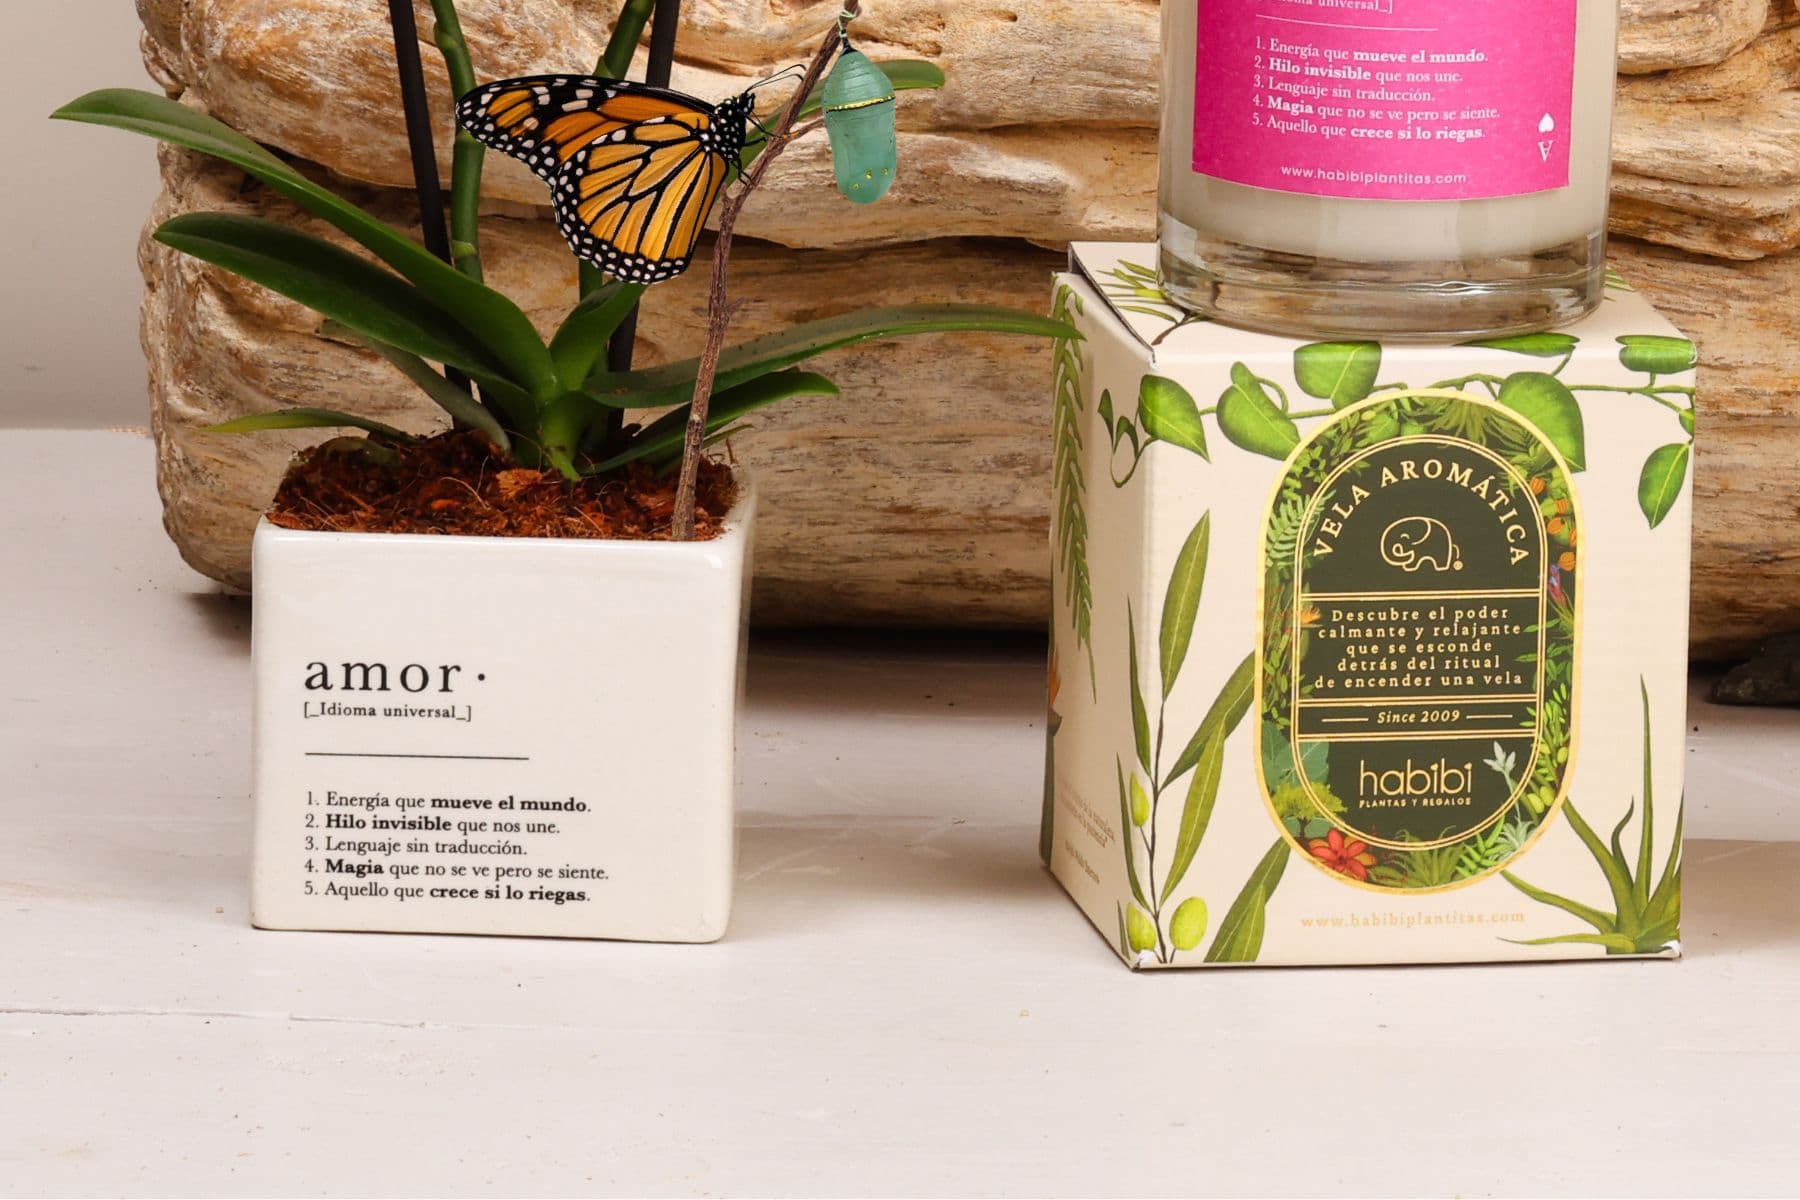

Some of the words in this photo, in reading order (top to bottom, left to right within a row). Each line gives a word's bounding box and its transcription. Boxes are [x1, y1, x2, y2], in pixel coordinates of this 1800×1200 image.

[1256, 36, 1265, 49] 1.
[1270, 39, 1319, 56] Energía
[1324, 48, 1349, 62] que
[1353, 51, 1407, 62] mueve
[1411, 50, 1426, 62] el
[1430, 49, 1488, 62] mundo.
[1254, 56, 1265, 69] 2.
[1269, 59, 1300, 73] Hilo
[1305, 63, 1371, 80] invisible
[1376, 71, 1401, 84] que
[1407, 72, 1430, 82] nos
[1254, 75, 1264, 88] 3.
[1269, 77, 1328, 99] Lenguaje
[1332, 84, 1351, 98] sin
[1356, 87, 1434, 102] traducción.
[1253, 95, 1263, 107] 4.
[1268, 97, 1313, 114] Magia
[1318, 104, 1343, 118] que
[1348, 107, 1365, 118] no
[1370, 108, 1383, 118] se
[1388, 109, 1402, 119] ve
[1408, 109, 1438, 124] pero
[1443, 110, 1457, 120] se
[1461, 106, 1500, 119] siente.
[1252, 113, 1263, 126] 5.
[1267, 116, 1317, 134] Aquello
[1321, 124, 1346, 139] que
[1351, 127, 1392, 139] crece
[1398, 126, 1412, 139] si
[1417, 127, 1432, 139] lo
[1436, 127, 1485, 143] riegas.
[1281, 165, 1467, 185] www.habibiplantitas.com
[1313, 485, 1370, 558] VELA
[1379, 459, 1530, 565] AROMÁTICA
[1332, 607, 1420, 622] Descubre
[1429, 607, 1445, 620] el
[1455, 606, 1509, 624] poder
[1318, 625, 1406, 638] calmante
[1415, 628, 1424, 640] y
[1434, 623, 1521, 638] relajante
[1346, 644, 1379, 657] que
[1389, 644, 1407, 654] se
[1416, 639, 1492, 653] esconde
[1338, 658, 1398, 672] detrás
[1407, 657, 1435, 670] del
[1445, 656, 1500, 669] ritual
[1315, 676, 1335, 688] de
[1344, 674, 1432, 688] encender
[1441, 676, 1474, 685] una
[1483, 672, 1522, 685] vela
[304, 702, 377, 719] [_Idioma
[383, 706, 472, 722] universal_]
[1377, 711, 1416, 724] Since
[1421, 710, 1460, 723] 2009
[1360, 758, 1472, 796] habibi
[306, 791, 319, 806] 1.
[327, 791, 389, 810] Energía
[395, 796, 425, 812] que
[431, 796, 492, 810] mueve
[499, 796, 515, 810] el
[520, 798, 592, 813] mundo.
[1359, 799, 1406, 808] PLANTAS
[1413, 799, 1417, 807] Y
[1423, 797, 1471, 806] REGALOS
[305, 814, 319, 829] 2.
[325, 815, 366, 830] Hilo
[372, 815, 452, 831] invisible
[457, 820, 488, 836] que
[493, 821, 520, 834] nos
[526, 821, 560, 834] une.
[305, 836, 319, 851] 3.
[326, 836, 401, 857] Lenguaje
[407, 838, 429, 854] sin
[435, 839, 527, 856] traducción.
[305, 859, 318, 873] 4.
[325, 859, 384, 879] Magia
[389, 863, 419, 880] que
[425, 864, 446, 876] no
[452, 865, 467, 877] se
[472, 866, 490, 877] ve
[495, 866, 532, 884] pero
[538, 867, 553, 879] se
[558, 864, 609, 880] siente.
[304, 881, 318, 896] 5.
[325, 882, 388, 900] Aquello
[394, 885, 424, 902] que
[430, 885, 479, 899] crece
[485, 885, 500, 899] si
[506, 885, 524, 901] lo
[529, 887, 591, 905] riegas.
